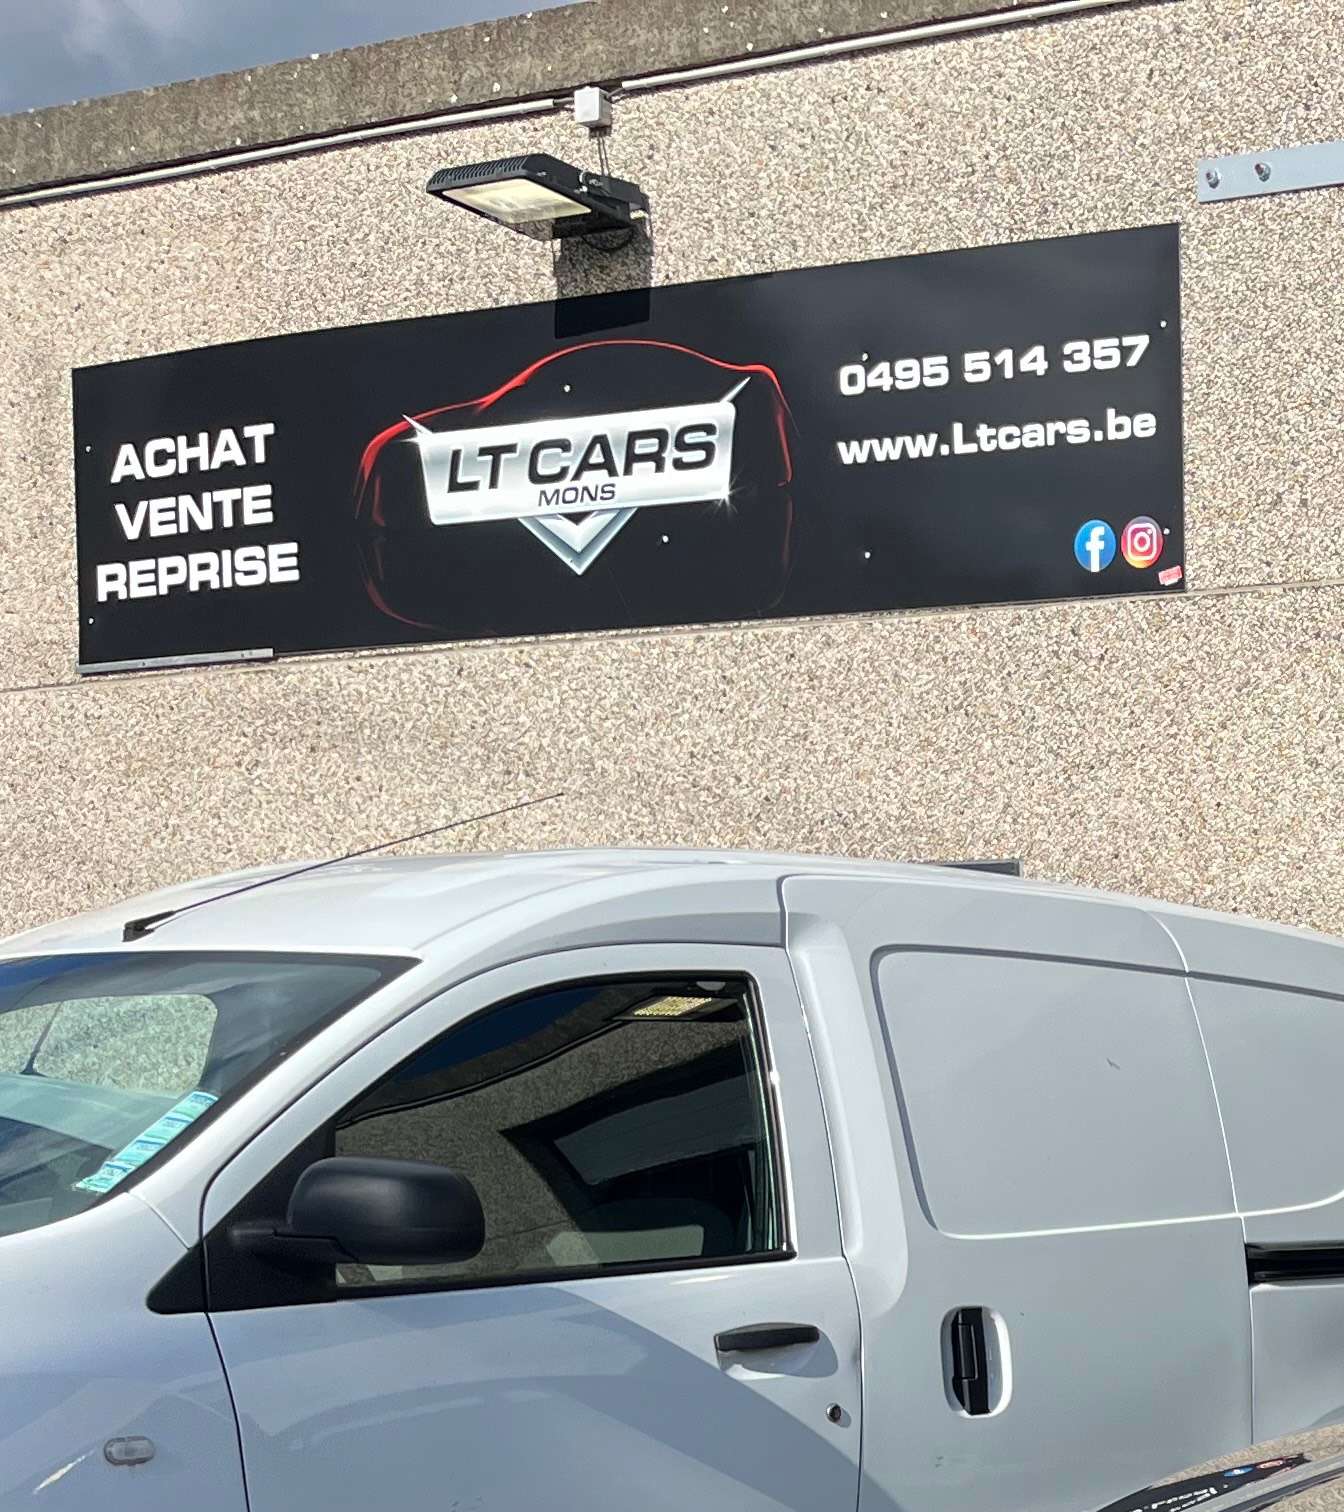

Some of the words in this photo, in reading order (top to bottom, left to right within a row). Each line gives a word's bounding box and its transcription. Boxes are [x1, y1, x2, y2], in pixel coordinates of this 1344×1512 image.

[839, 355, 949, 396] 0495
[963, 345, 1049, 384] 514
[1063, 335, 1150, 374] 357
[110, 423, 275, 484] ACHAT
[447, 443, 519, 493] LT
[527, 423, 717, 485] CARS
[837, 408, 1157, 465] www.Ltcars.be
[114, 484, 274, 541] VENTE
[538, 483, 616, 507] MONS
[97, 542, 299, 602] REPRISE
